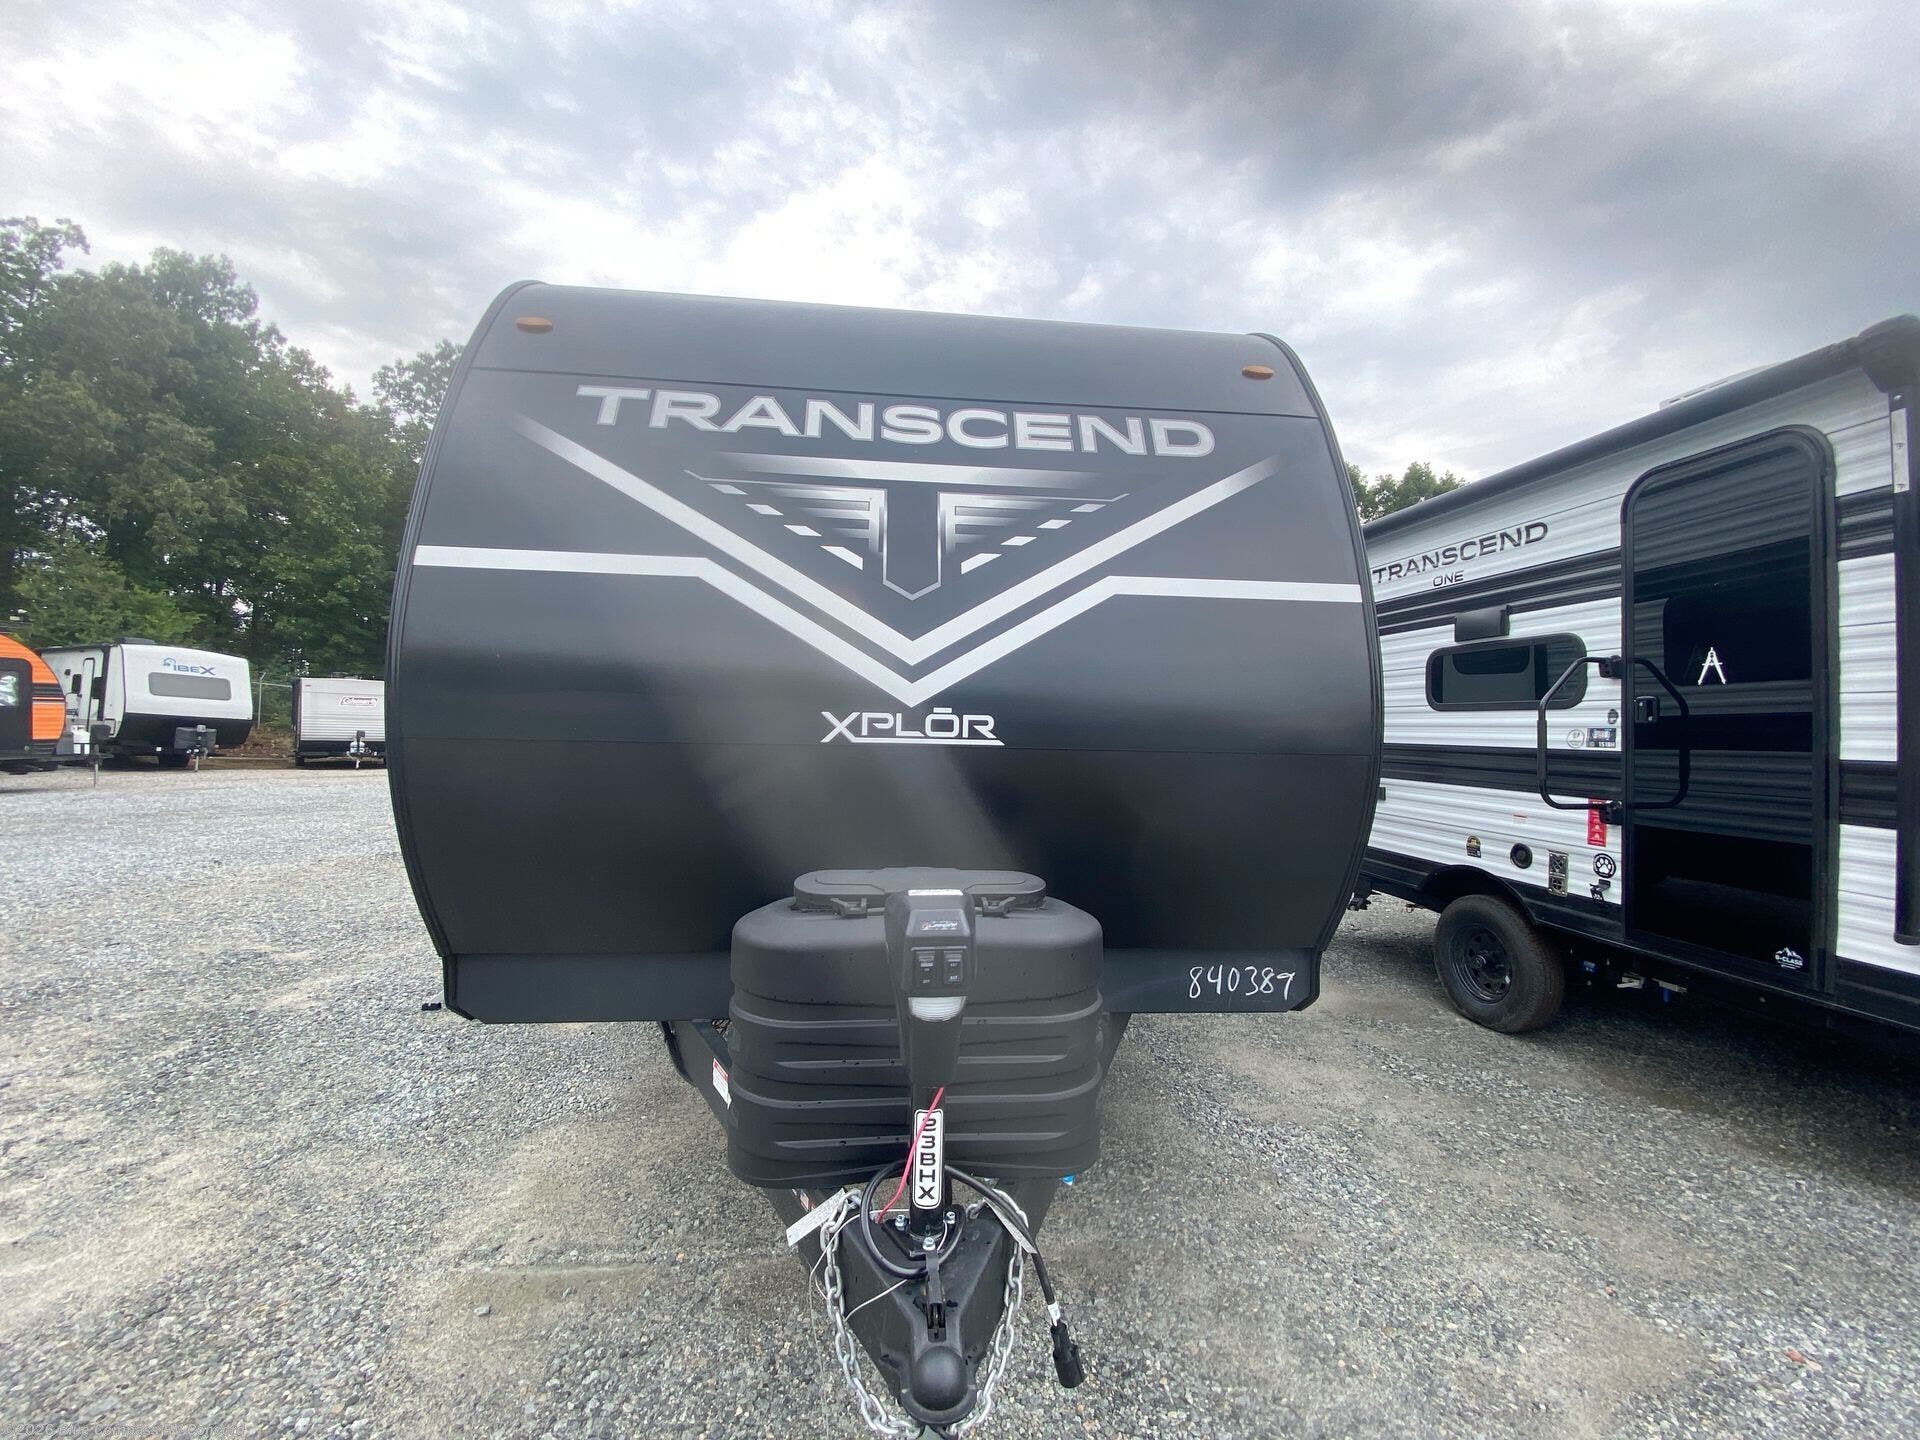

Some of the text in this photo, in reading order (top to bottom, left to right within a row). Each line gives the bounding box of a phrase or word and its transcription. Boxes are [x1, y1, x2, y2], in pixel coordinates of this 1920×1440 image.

[576, 384, 1216, 458] TRANSCEND
[1373, 522, 1548, 583] TRANSCEND
[1433, 570, 1464, 587] ONE
[173, 664, 216, 676] IBEX
[1189, 965, 1296, 1000] 840387
[918, 1118, 936, 1200] 23BHX
